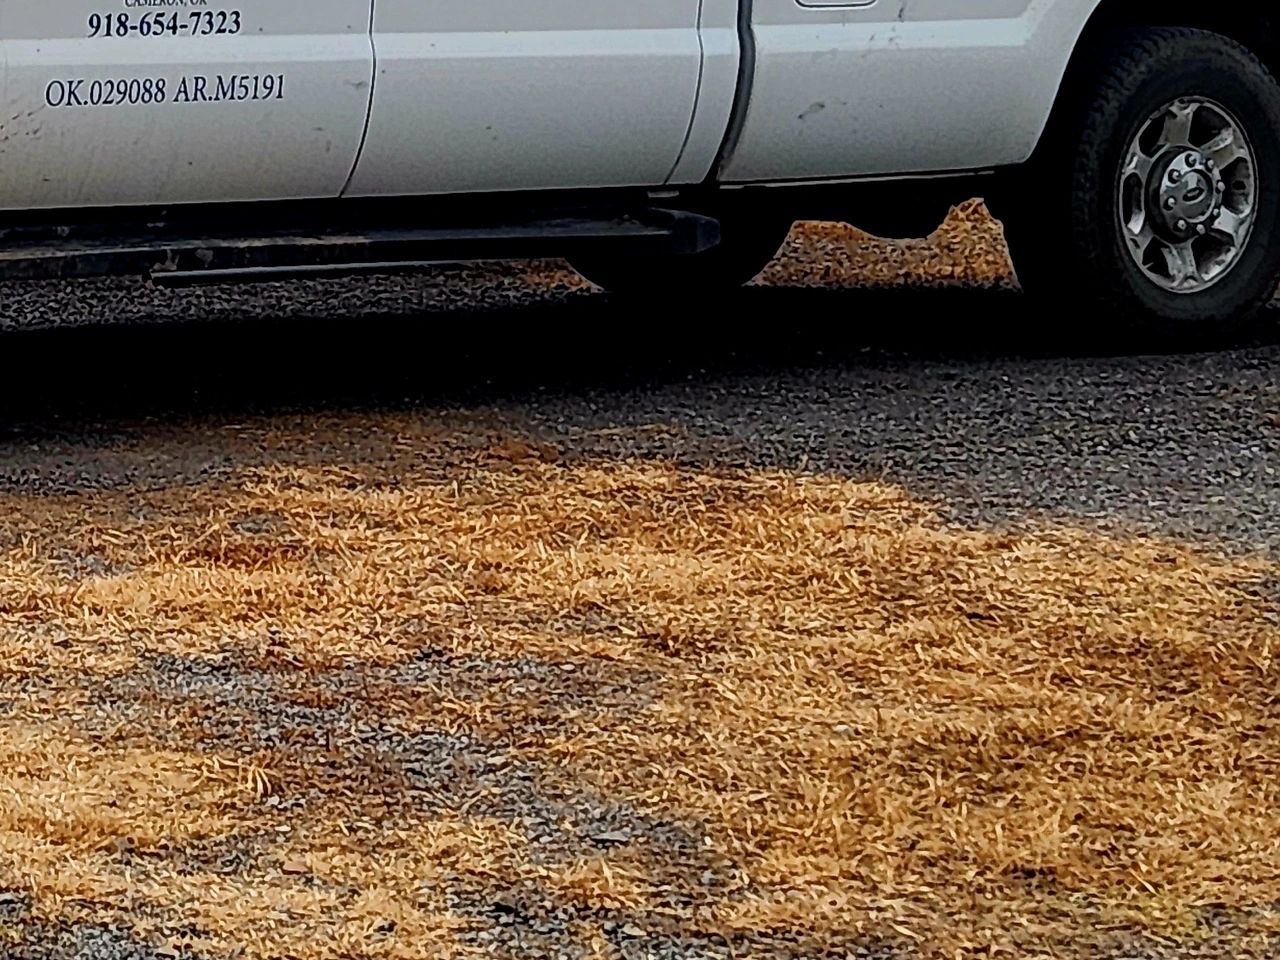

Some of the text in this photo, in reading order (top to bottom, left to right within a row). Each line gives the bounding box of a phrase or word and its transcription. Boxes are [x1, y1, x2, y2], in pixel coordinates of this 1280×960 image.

[87, 10, 242, 38] 918-654-7323
[45, 74, 285, 107] OK.029088 AR.M5191
